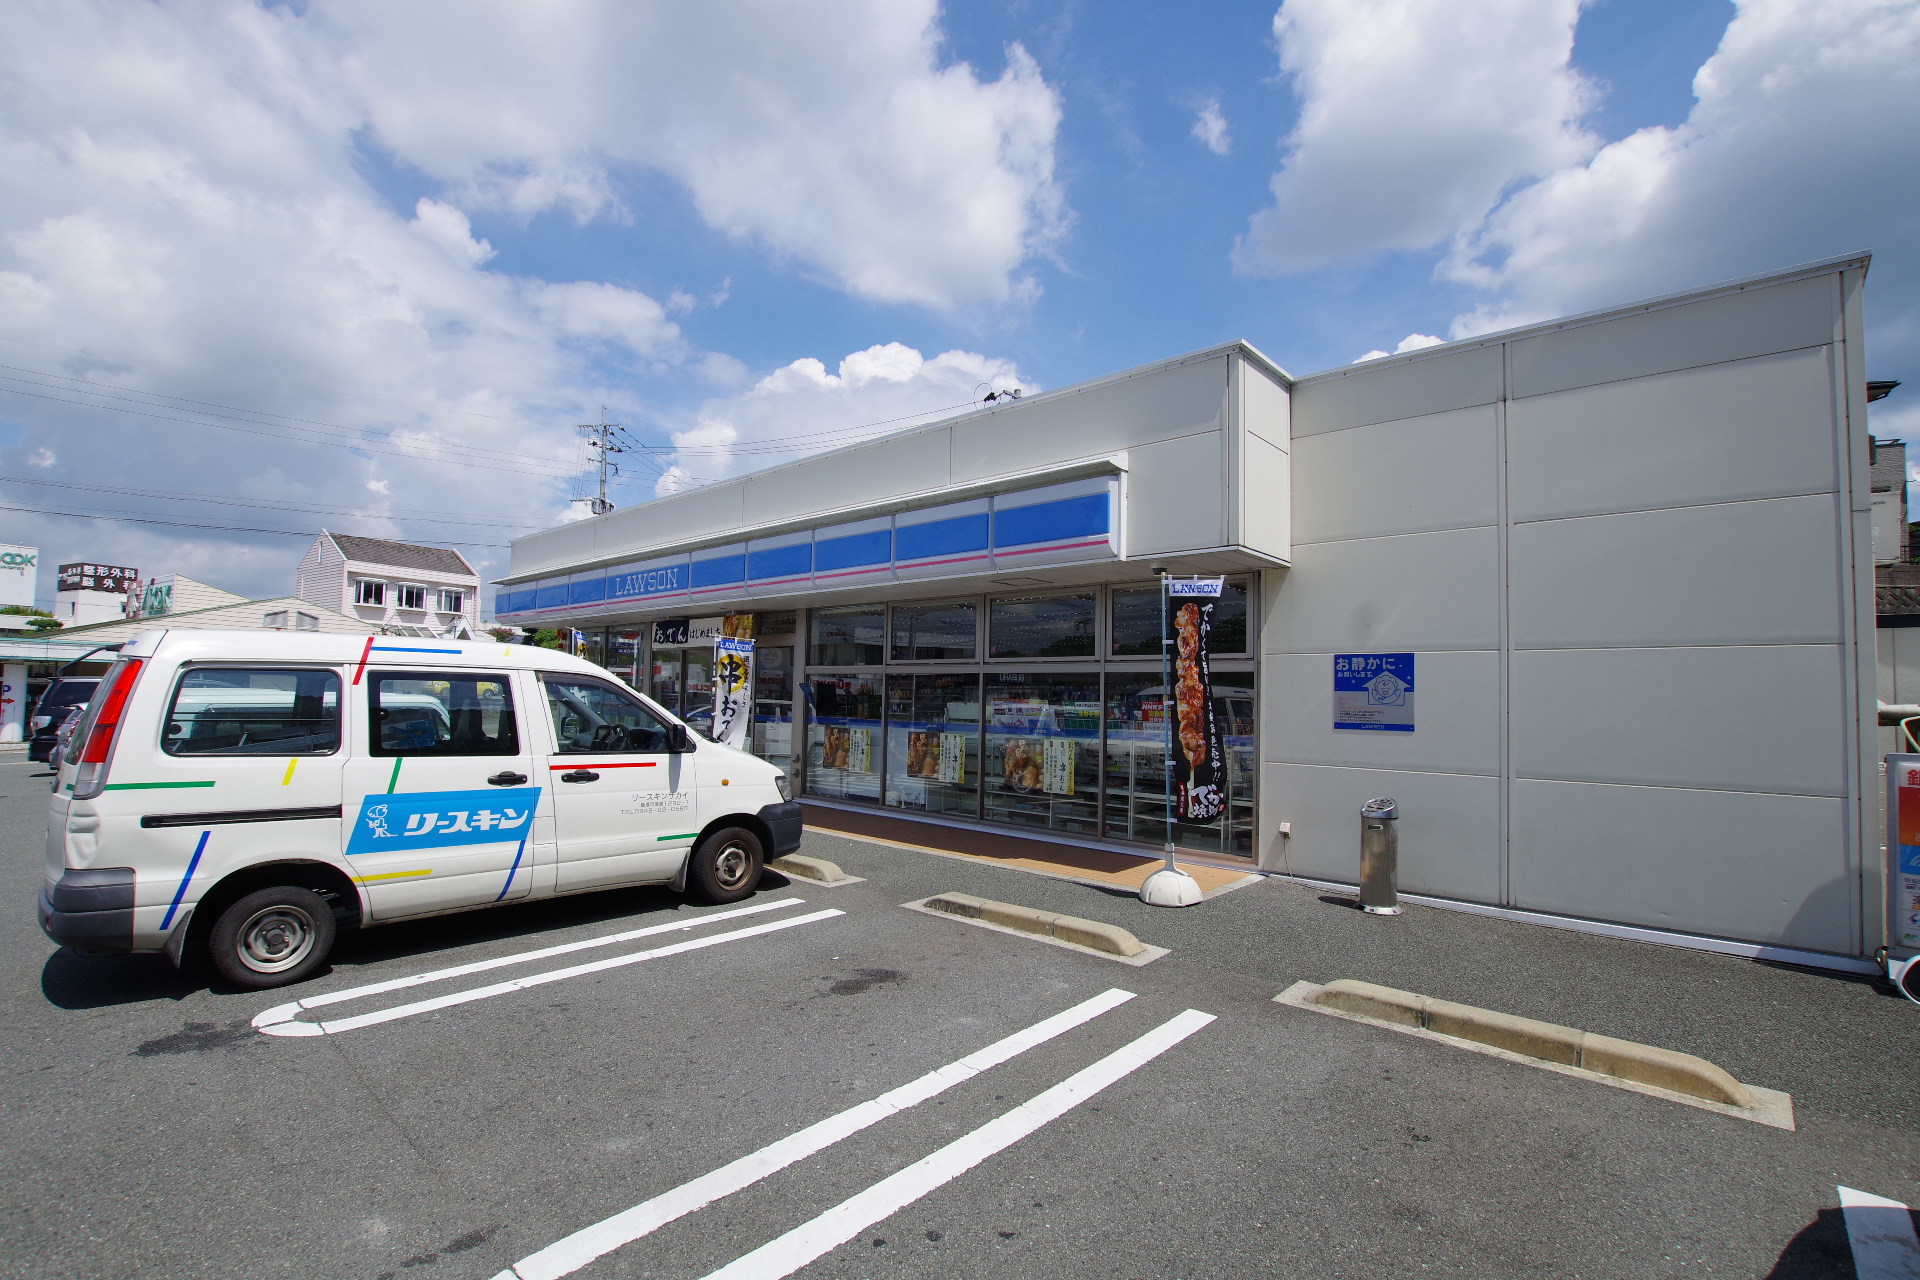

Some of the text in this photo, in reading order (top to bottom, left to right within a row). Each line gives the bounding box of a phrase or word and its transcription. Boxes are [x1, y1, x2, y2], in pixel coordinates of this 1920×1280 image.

[82, 565, 136, 579] 整形外科
[615, 568, 679, 595] LAWSON
[1171, 584, 1220, 594] LAWSON
[655, 627, 687, 643] おでん
[719, 641, 752, 651] LAWSON
[1336, 657, 1396, 671] お静かに
[632, 791, 688, 801] リースキンサカイ
[404, 808, 529, 836] リースキン
